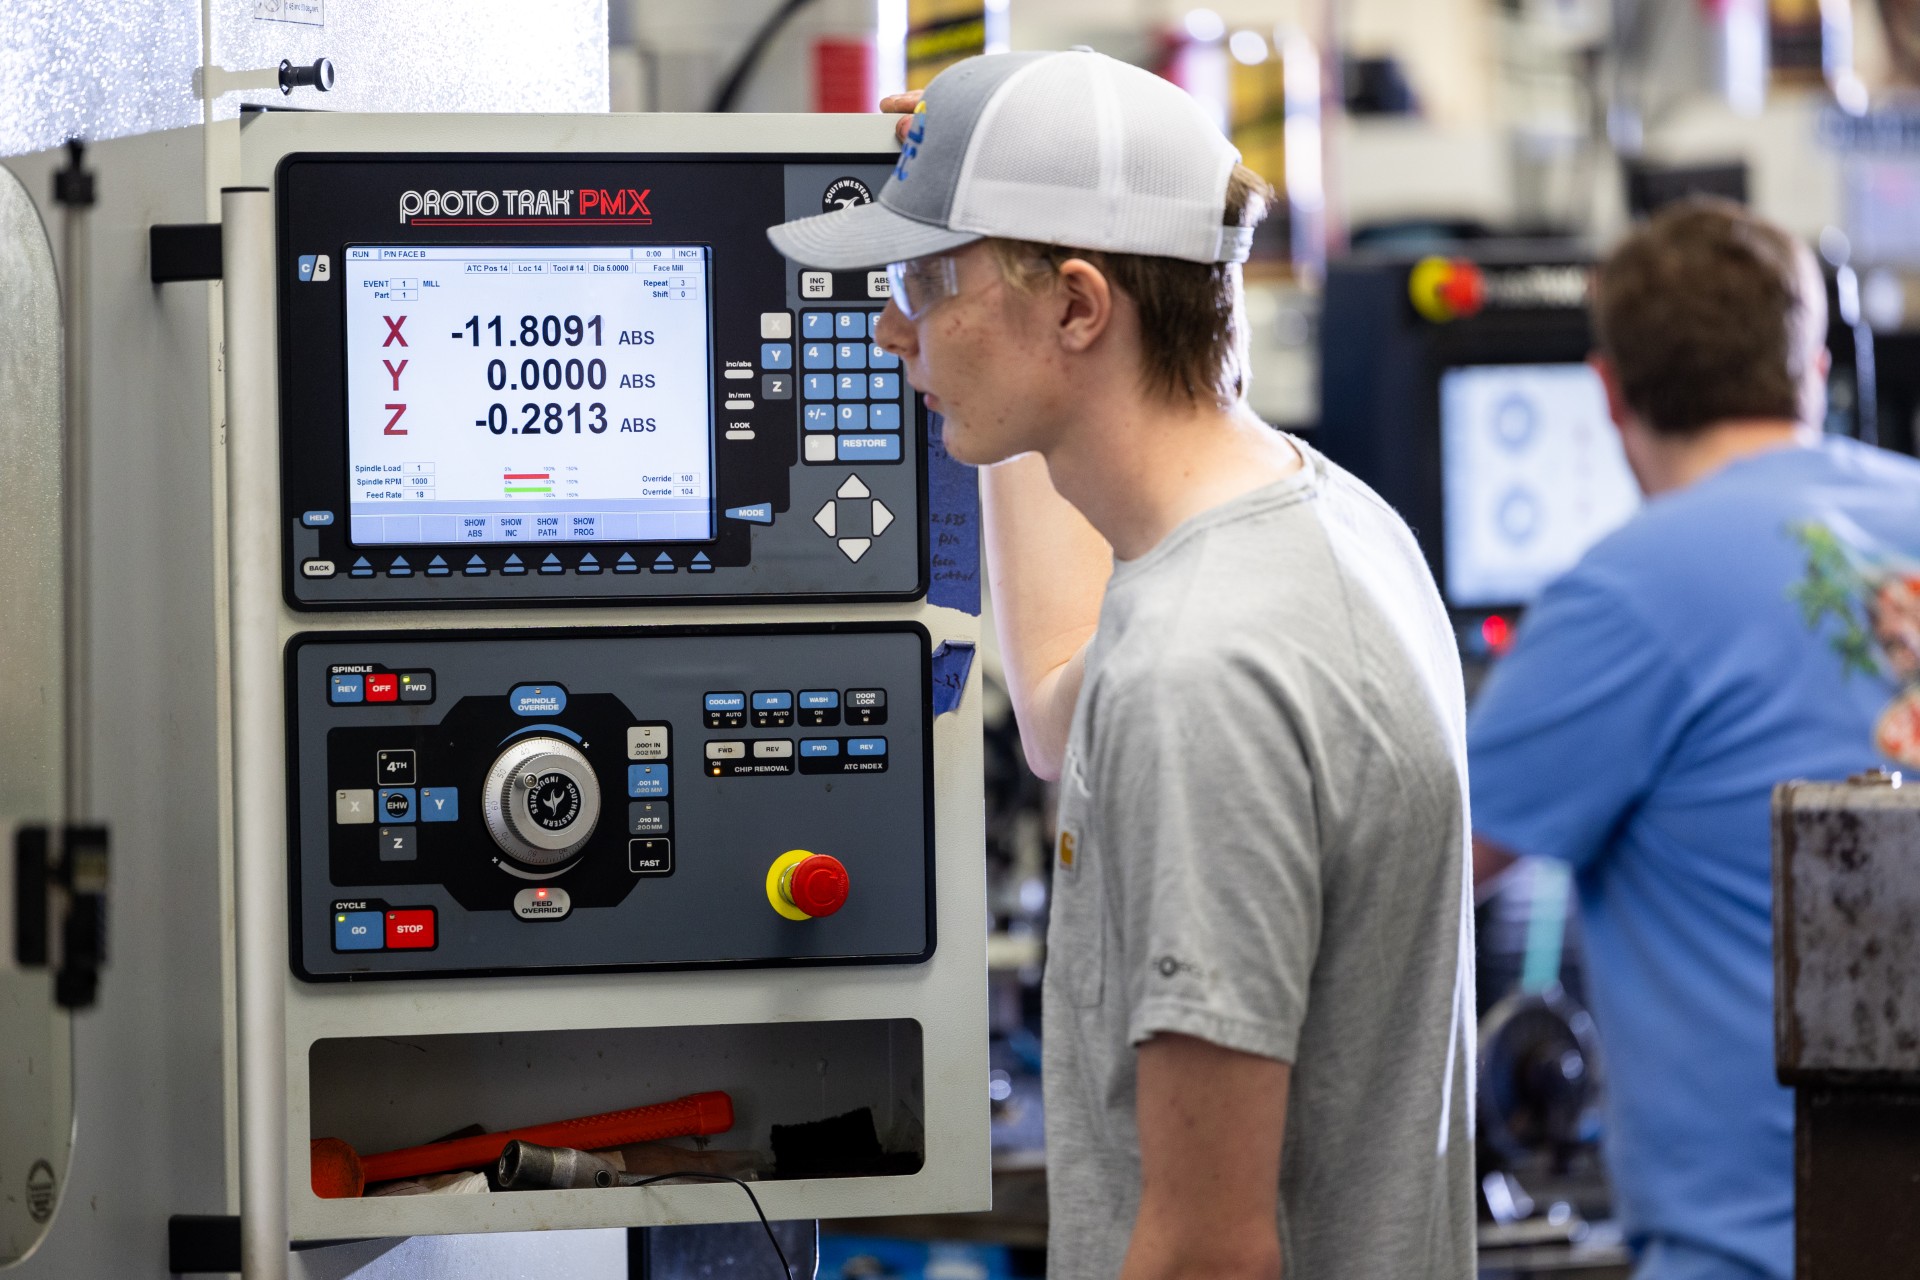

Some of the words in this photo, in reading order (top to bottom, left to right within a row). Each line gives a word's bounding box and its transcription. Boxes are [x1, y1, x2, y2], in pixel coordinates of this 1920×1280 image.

[824, 180, 871, 204] SOUTHWESTERN
[579, 189, 652, 215] PMX
[352, 250, 369, 258] RUN
[398, 250, 418, 258] FACE
[420, 250, 426, 258] B
[646, 250, 662, 258] 0:00
[466, 264, 482, 272] ATC
[483, 264, 498, 272] Pos
[500, 264, 508, 272] 14
[518, 264, 532, 272] Loc
[534, 264, 542, 272] 14
[552, 264, 569, 272] Tool
[576, 264, 584, 272] 14
[593, 264, 605, 272] Dia
[606, 264, 629, 272] 5.0000
[653, 264, 670, 272] Face
[671, 264, 684, 272] Mill
[363, 280, 389, 288] EVENT
[422, 280, 440, 288] MILL
[643, 279, 668, 288] Repeat
[680, 279, 685, 287] 3
[374, 291, 390, 299] Part
[652, 290, 668, 298] Shift
[681, 290, 686, 298] 0
[808, 316, 818, 327] 7
[840, 316, 850, 327] 8
[382, 315, 409, 347] X
[618, 330, 655, 345] ABS
[808, 347, 818, 358] 4
[841, 347, 851, 358] 5
[873, 346, 883, 357] 6
[772, 350, 781, 362] Y
[382, 359, 409, 391] Y
[487, 358, 607, 391] 0.0000
[619, 374, 656, 389] ABS
[772, 382, 782, 392] Z
[811, 378, 817, 388] 1
[842, 378, 851, 388] 2
[874, 378, 883, 388] 3
[842, 408, 852, 419] 0
[383, 403, 409, 435] Z
[475, 402, 608, 435] -0.2813
[620, 417, 657, 433] ABS
[843, 439, 887, 448] RESTORE
[355, 465, 381, 473] Spindle
[356, 478, 382, 486] Spindle
[642, 474, 672, 482] Override
[681, 474, 693, 482] 100
[642, 487, 672, 495] Override
[681, 487, 693, 495] 104
[739, 509, 764, 517] MODE
[464, 518, 486, 527] SHOW
[500, 518, 522, 526] SHOW
[537, 518, 558, 526] SHOW
[573, 517, 595, 525] SHOW
[467, 529, 483, 538] ABS
[505, 529, 517, 537] INC
[538, 528, 557, 537] PATH
[573, 528, 595, 536] PROG
[332, 665, 373, 673] SPINDLE
[337, 685, 357, 693] REV
[372, 684, 391, 692] OFF
[405, 684, 426, 692] FWD
[518, 703, 559, 711] OVERRIDE
[387, 761, 407, 773] 4TH
[754, 765, 789, 773] REMOVAL
[530, 776, 559, 815] INDUSTRIES
[350, 801, 360, 812] X
[387, 801, 408, 810] EHW
[434, 799, 445, 810] Y
[543, 783, 579, 828] SOUTHWESTERN
[393, 838, 403, 848] Z
[336, 902, 366, 910] CYCLE
[522, 906, 563, 914] OVERRIDE
[351, 926, 367, 935] GO
[396, 925, 423, 934] STOP
